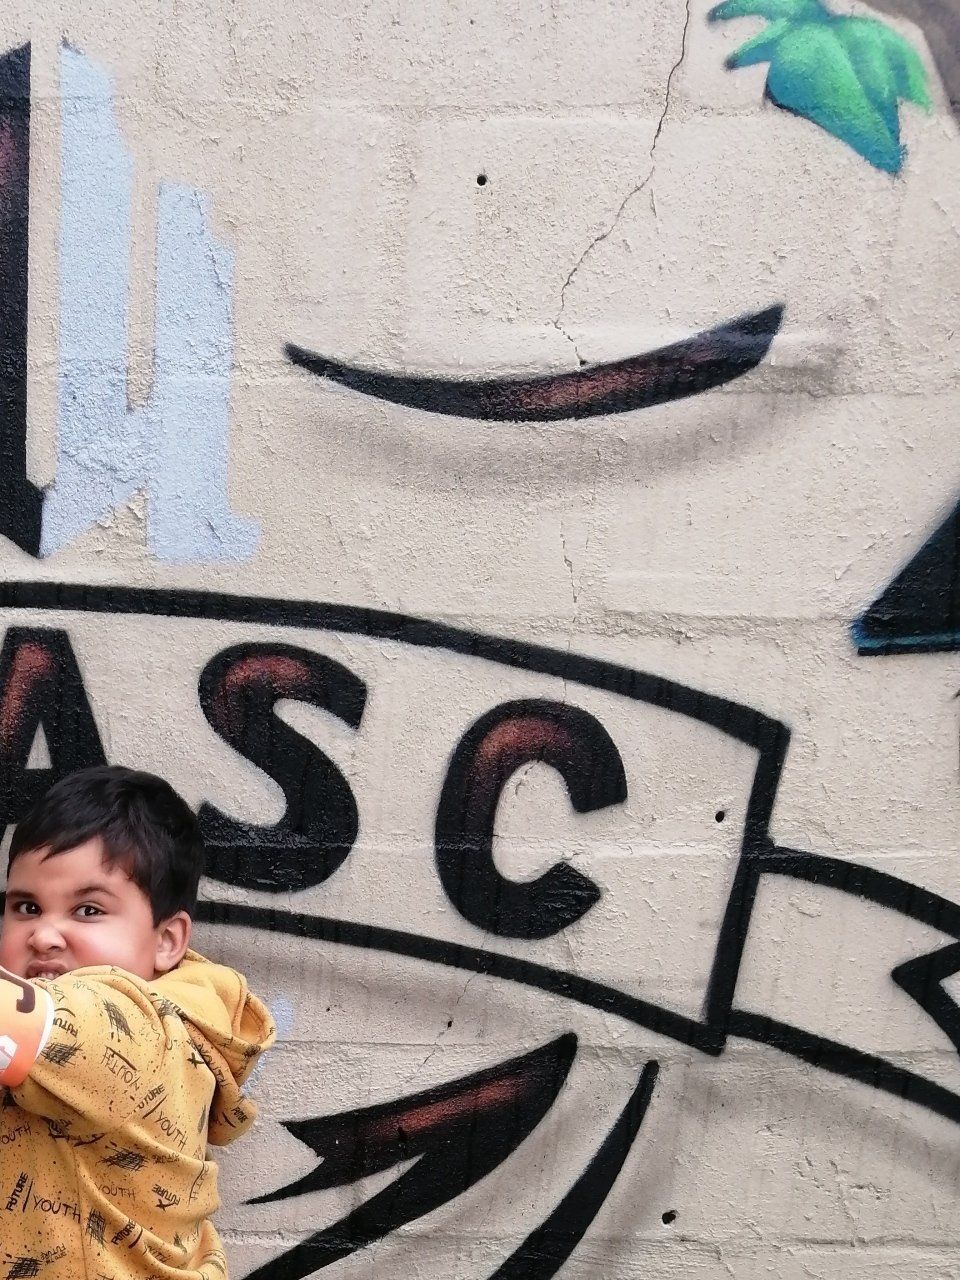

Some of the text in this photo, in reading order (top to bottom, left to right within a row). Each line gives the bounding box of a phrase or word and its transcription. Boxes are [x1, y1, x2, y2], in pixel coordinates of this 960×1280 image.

[133, 1083, 166, 1113] UTURE
[154, 1110, 189, 1151] YOUTH
[5, 1172, 29, 1212] FUTURE
[94, 1181, 136, 1201] YOUTH
[152, 1184, 181, 1206] FUTURE
[33, 1195, 81, 1224] YOUTH
